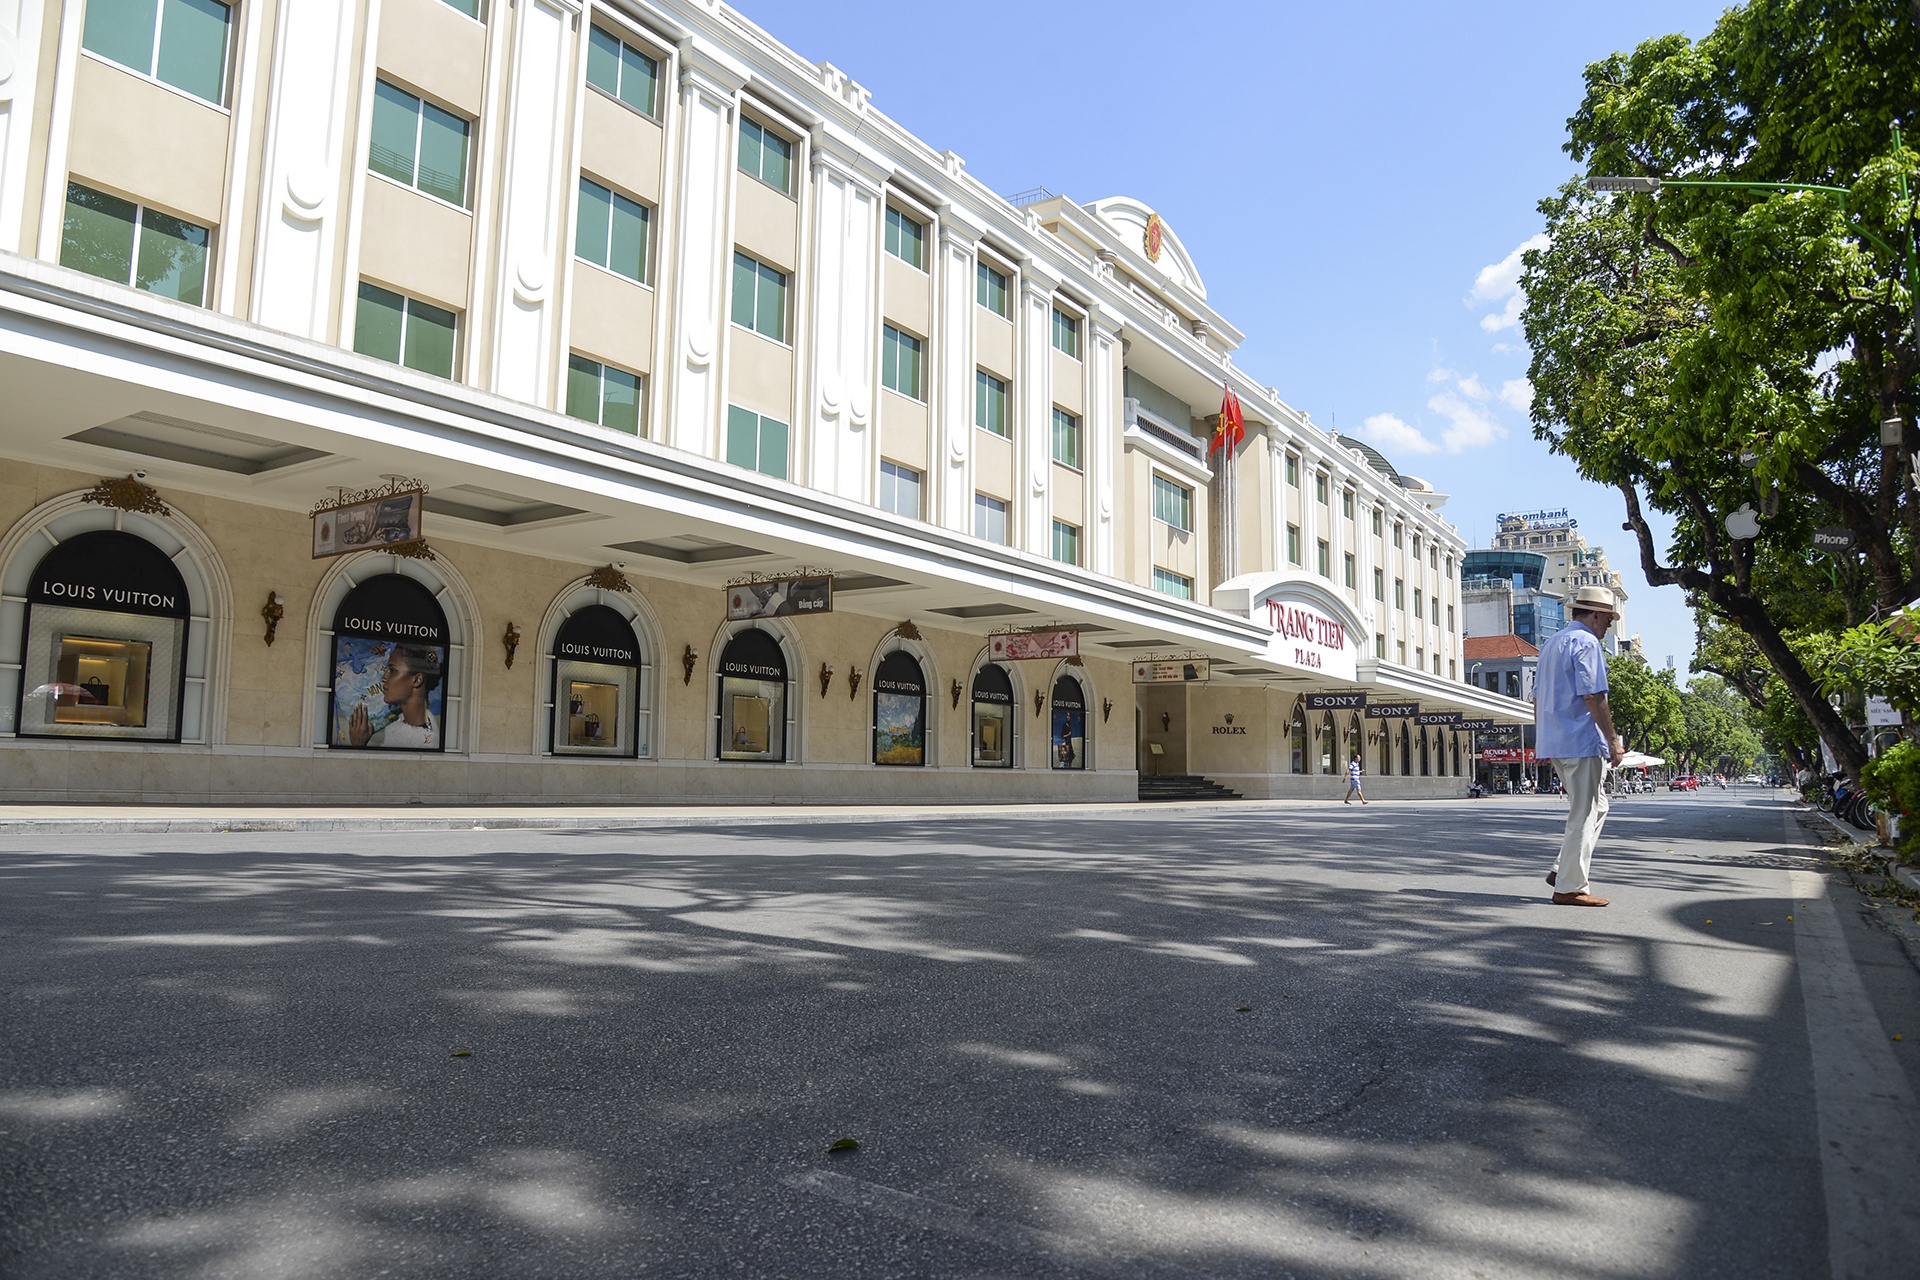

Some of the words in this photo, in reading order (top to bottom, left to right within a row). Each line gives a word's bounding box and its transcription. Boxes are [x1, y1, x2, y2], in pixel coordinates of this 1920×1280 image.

[1814, 533, 1849, 545] iPhone
[43, 580, 96, 601] LOUIS
[102, 588, 176, 609] VUITTON
[344, 617, 382, 632] LOUIS
[386, 622, 439, 638] VUITTON
[1266, 598, 1315, 642] TRANG
[1316, 616, 1345, 650] TIEN
[561, 643, 590, 655] LOUIS
[593, 646, 632, 660] VUITTON
[1295, 648, 1322, 669] PLAZA
[725, 662, 748, 674] LOUIS
[749, 665, 780, 677] VUITTON
[878, 680, 896, 690] LOUIS
[897, 682, 921, 692] VUITTON
[975, 690, 989, 700] LOUIS
[989, 692, 1009, 702] VUITTON
[1314, 697, 1359, 706] SONY
[1053, 699, 1064, 708] LOUIS
[1065, 701, 1082, 709] VUITTON
[1371, 707, 1412, 716] SONY
[1420, 715, 1457, 723] SONY
[1212, 726, 1247, 735] ROLEX
[1454, 721, 1488, 730] SONY
